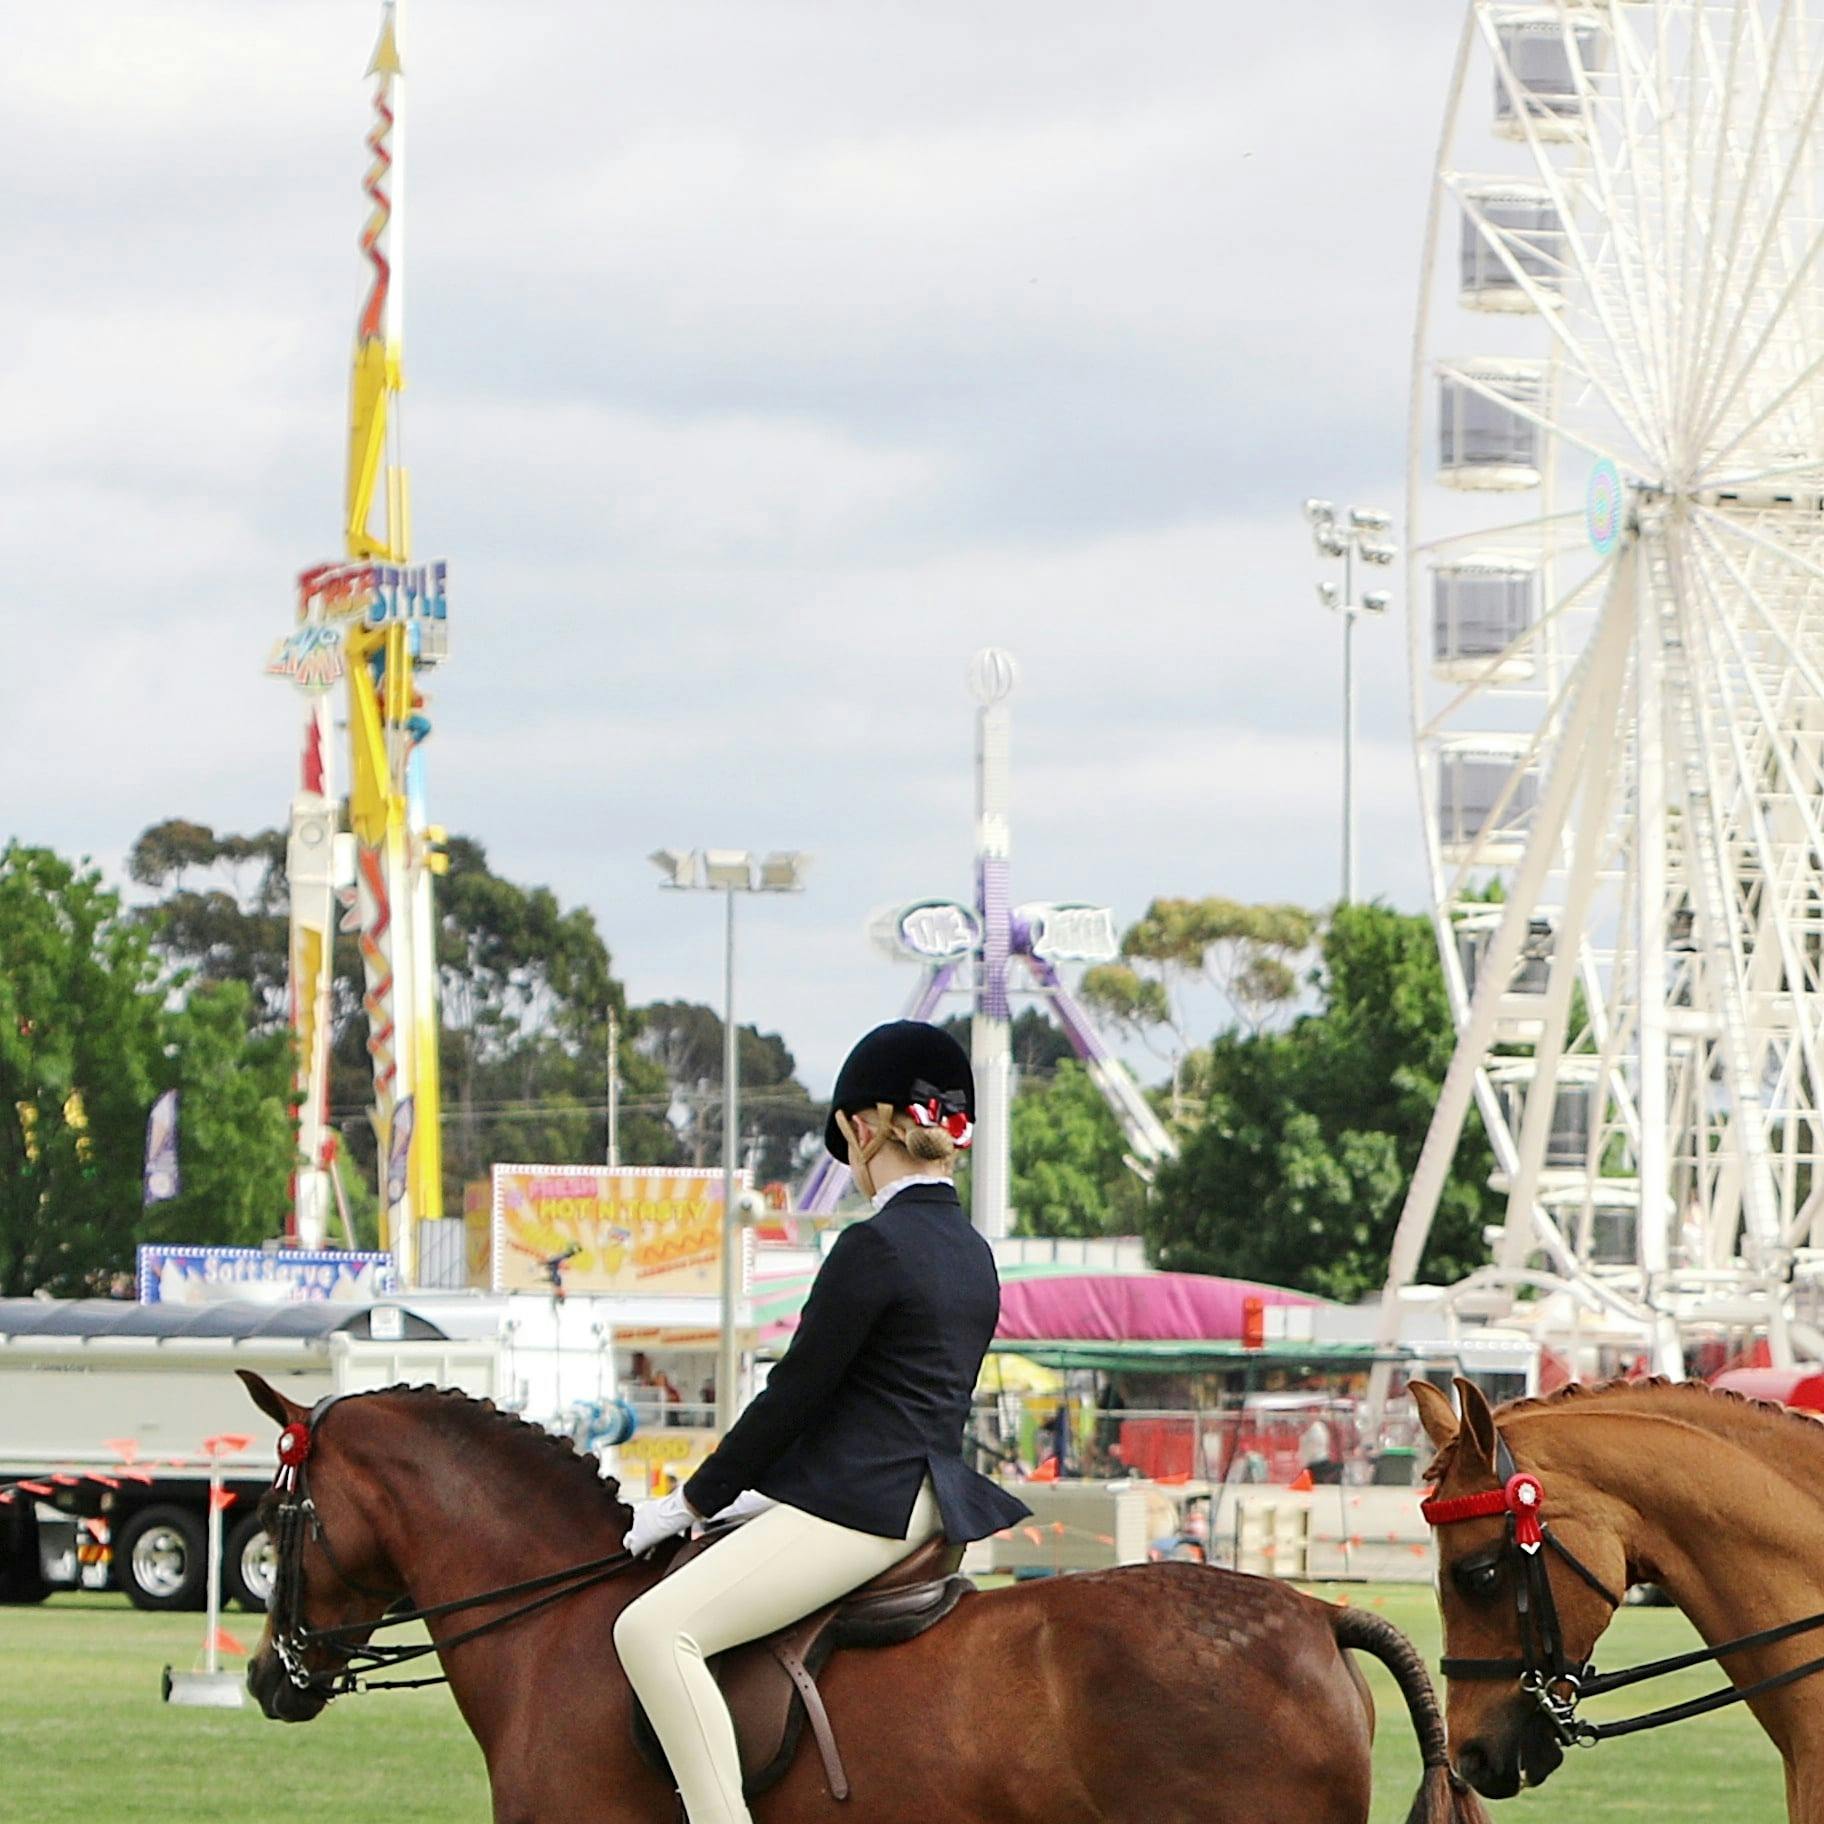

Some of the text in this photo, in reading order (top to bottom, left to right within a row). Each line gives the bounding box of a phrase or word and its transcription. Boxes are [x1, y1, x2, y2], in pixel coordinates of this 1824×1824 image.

[540, 1199, 706, 1221] HOT N TASTY
[204, 1258, 332, 1286] Soft Serve
